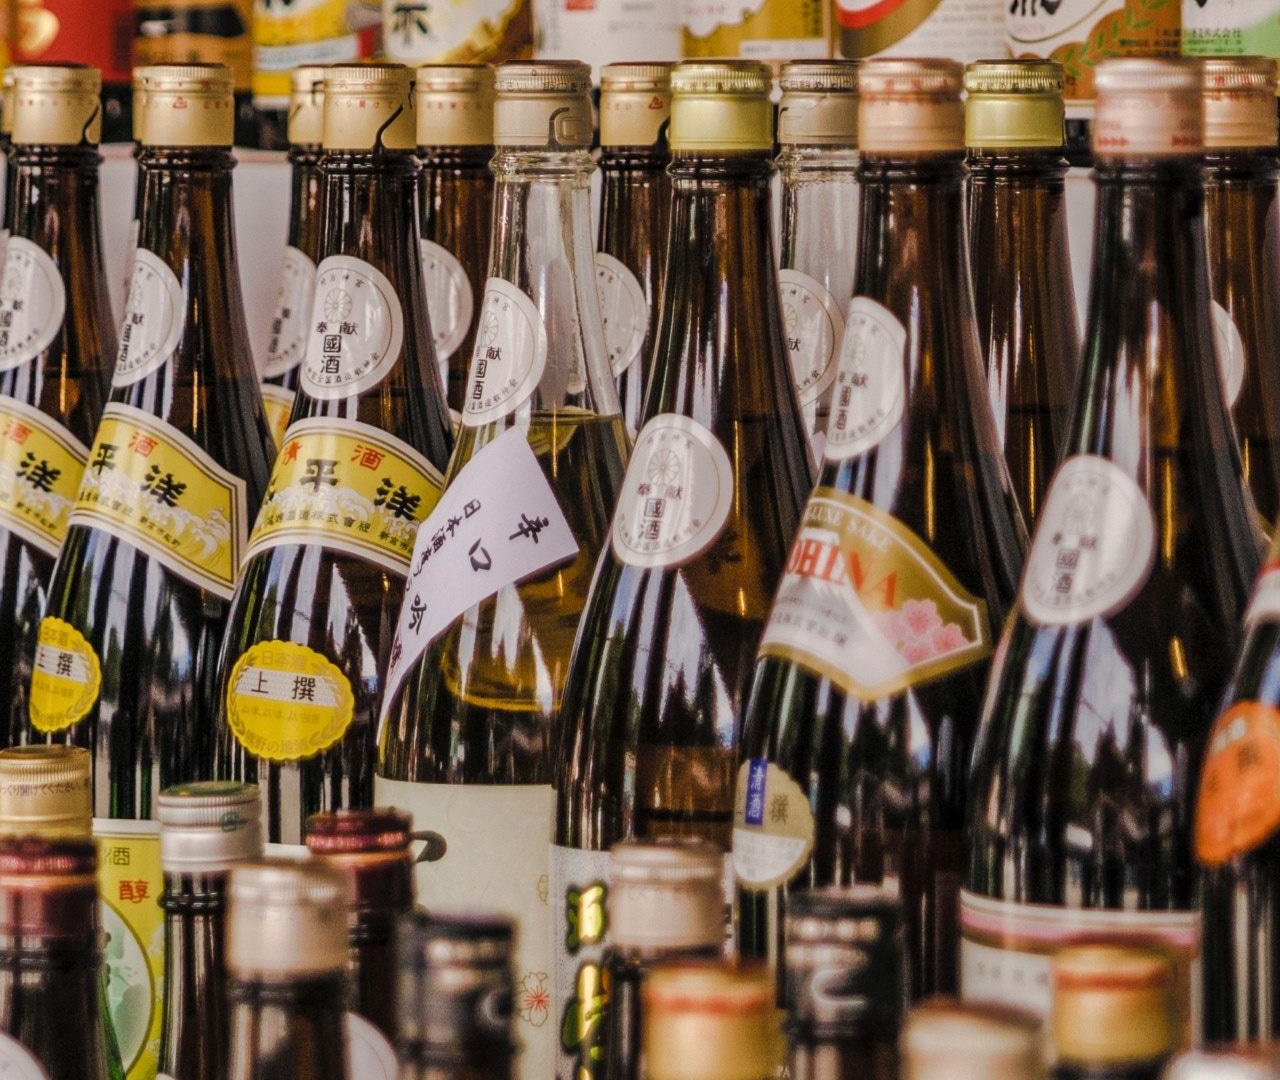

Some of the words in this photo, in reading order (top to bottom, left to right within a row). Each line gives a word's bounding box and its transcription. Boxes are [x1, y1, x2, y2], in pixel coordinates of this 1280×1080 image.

[316, 320, 359, 336] 奉献
[321, 334, 342, 375] 國酒
[269, 459, 422, 522] 平洋
[250, 671, 317, 702] 上撰
